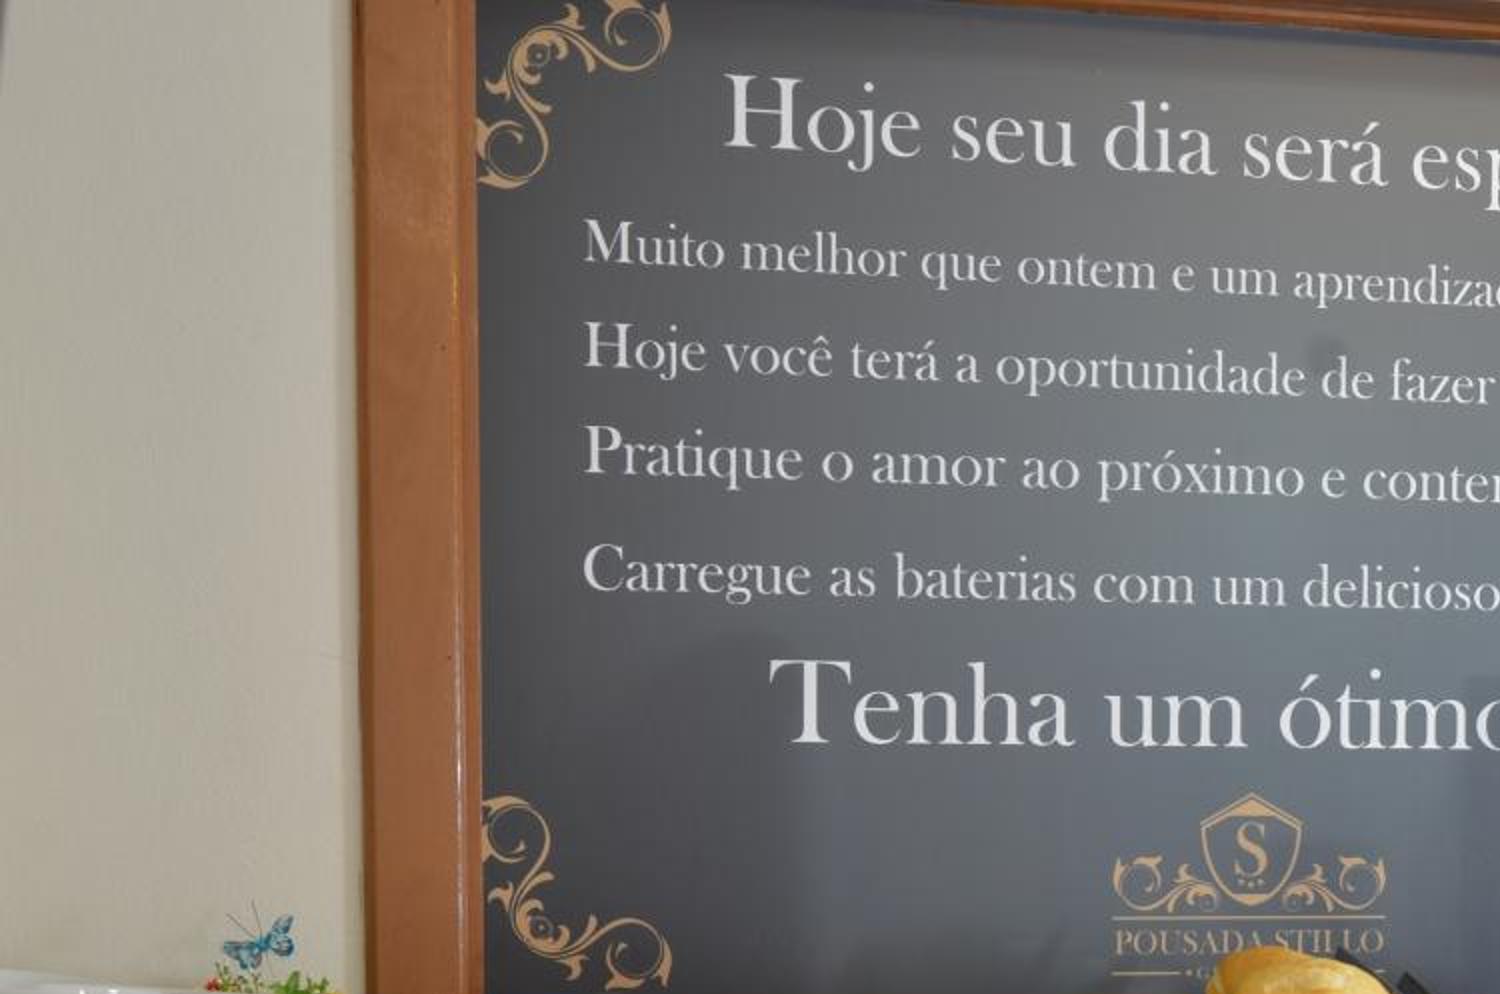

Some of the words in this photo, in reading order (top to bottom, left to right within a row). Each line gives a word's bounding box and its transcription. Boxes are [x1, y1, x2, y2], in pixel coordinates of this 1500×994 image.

[723, 73, 921, 173] Hoje
[951, 113, 1077, 168] seu
[1103, 99, 1219, 177] dia
[1242, 121, 1390, 188] será
[583, 218, 726, 269] Muito
[739, 230, 908, 278] melhor
[920, 251, 1003, 292] que
[1017, 254, 1157, 291] ontem
[1171, 265, 1195, 292] e
[1209, 266, 1280, 297] um
[583, 321, 707, 381] Hoje
[722, 335, 833, 378] você
[850, 339, 941, 382] terá
[954, 353, 981, 384] a
[995, 347, 1306, 398] oportunidade
[1321, 354, 1375, 400] de
[1391, 357, 1497, 405] fazer
[583, 425, 803, 492] Pratique
[821, 450, 854, 482] o
[871, 452, 1007, 488] amor
[1021, 457, 1081, 490] ao
[1097, 447, 1305, 503] próximo
[1321, 468, 1346, 499] e
[583, 543, 812, 605] Carregue
[829, 566, 877, 598] as
[893, 551, 1077, 602] baterias
[1093, 573, 1195, 605] com
[1212, 575, 1287, 607] um
[769, 658, 1076, 748] Tenha
[1103, 693, 1249, 748] um
[1114, 928, 1263, 956] POUSADA
